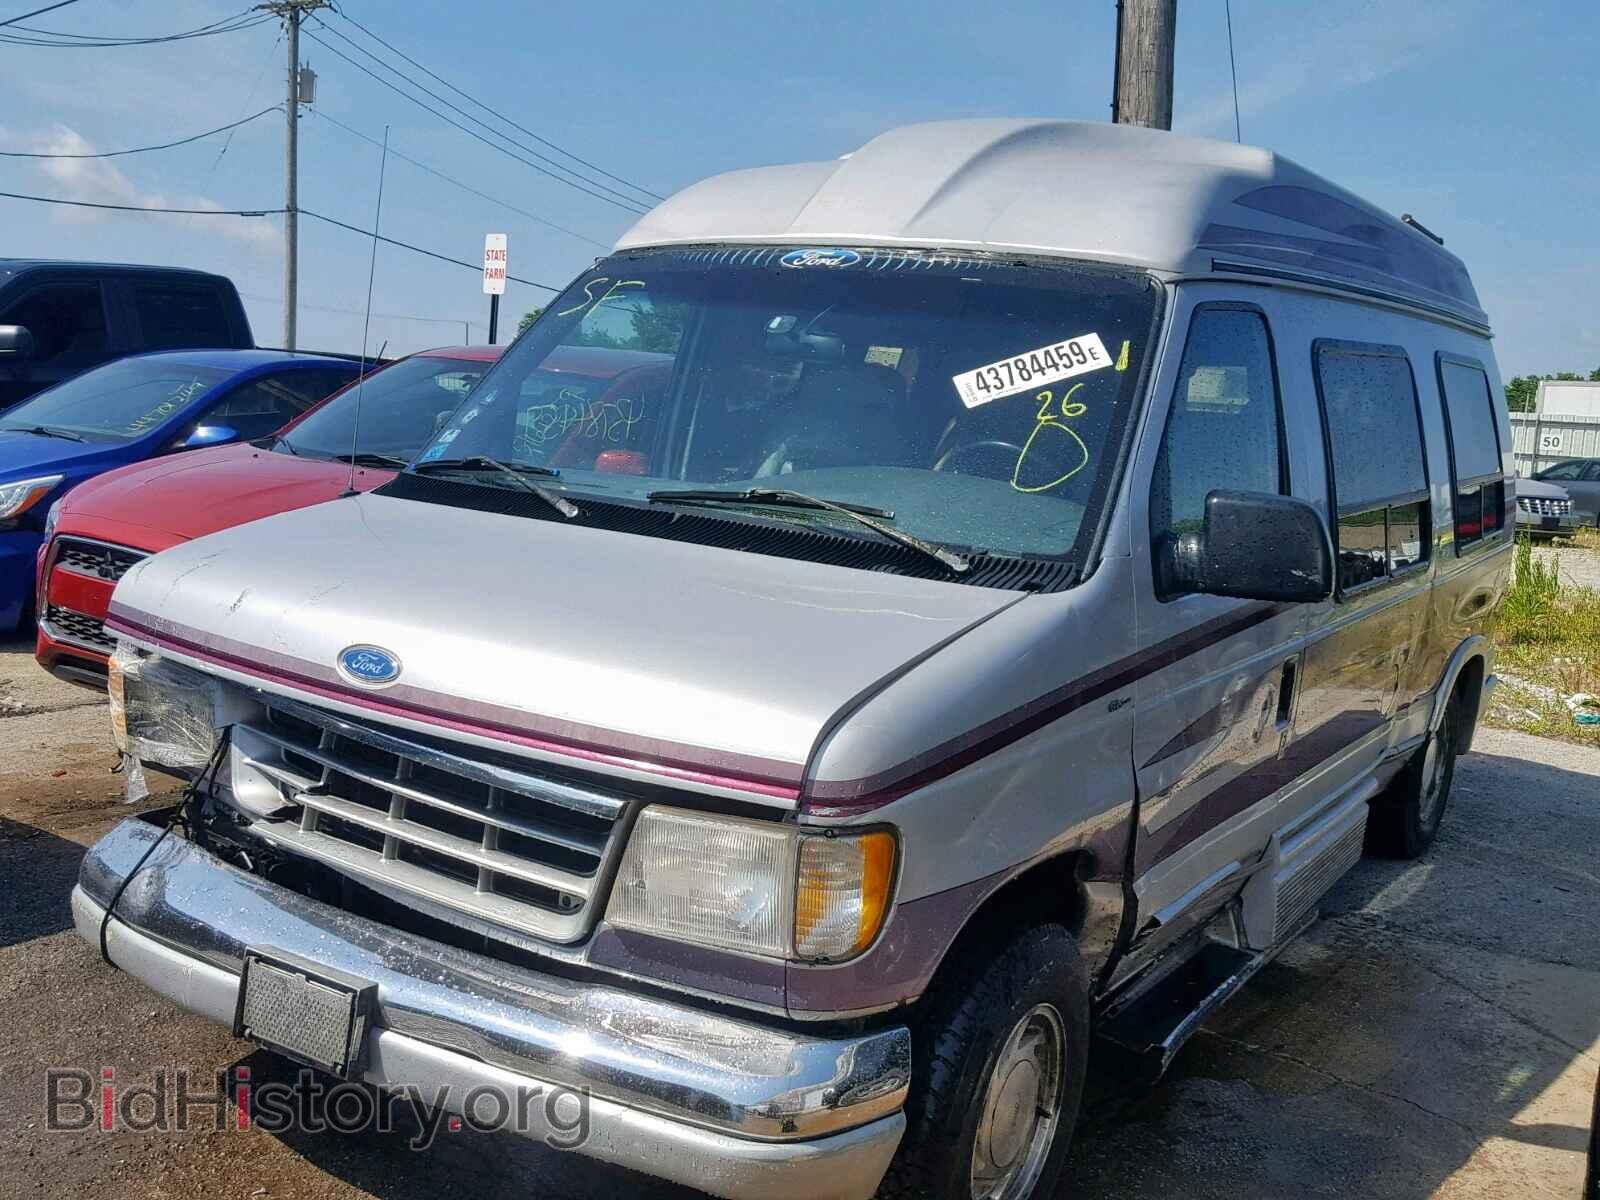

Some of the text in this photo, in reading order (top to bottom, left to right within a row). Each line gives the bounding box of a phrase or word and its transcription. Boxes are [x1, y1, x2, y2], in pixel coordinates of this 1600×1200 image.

[485, 249, 506, 261] STATE
[484, 267, 506, 281] FARM
[975, 340, 1088, 394] 43784459
[1088, 347, 1101, 361] E
[1035, 383, 1088, 421] 26
[1543, 436, 1560, 448] 50
